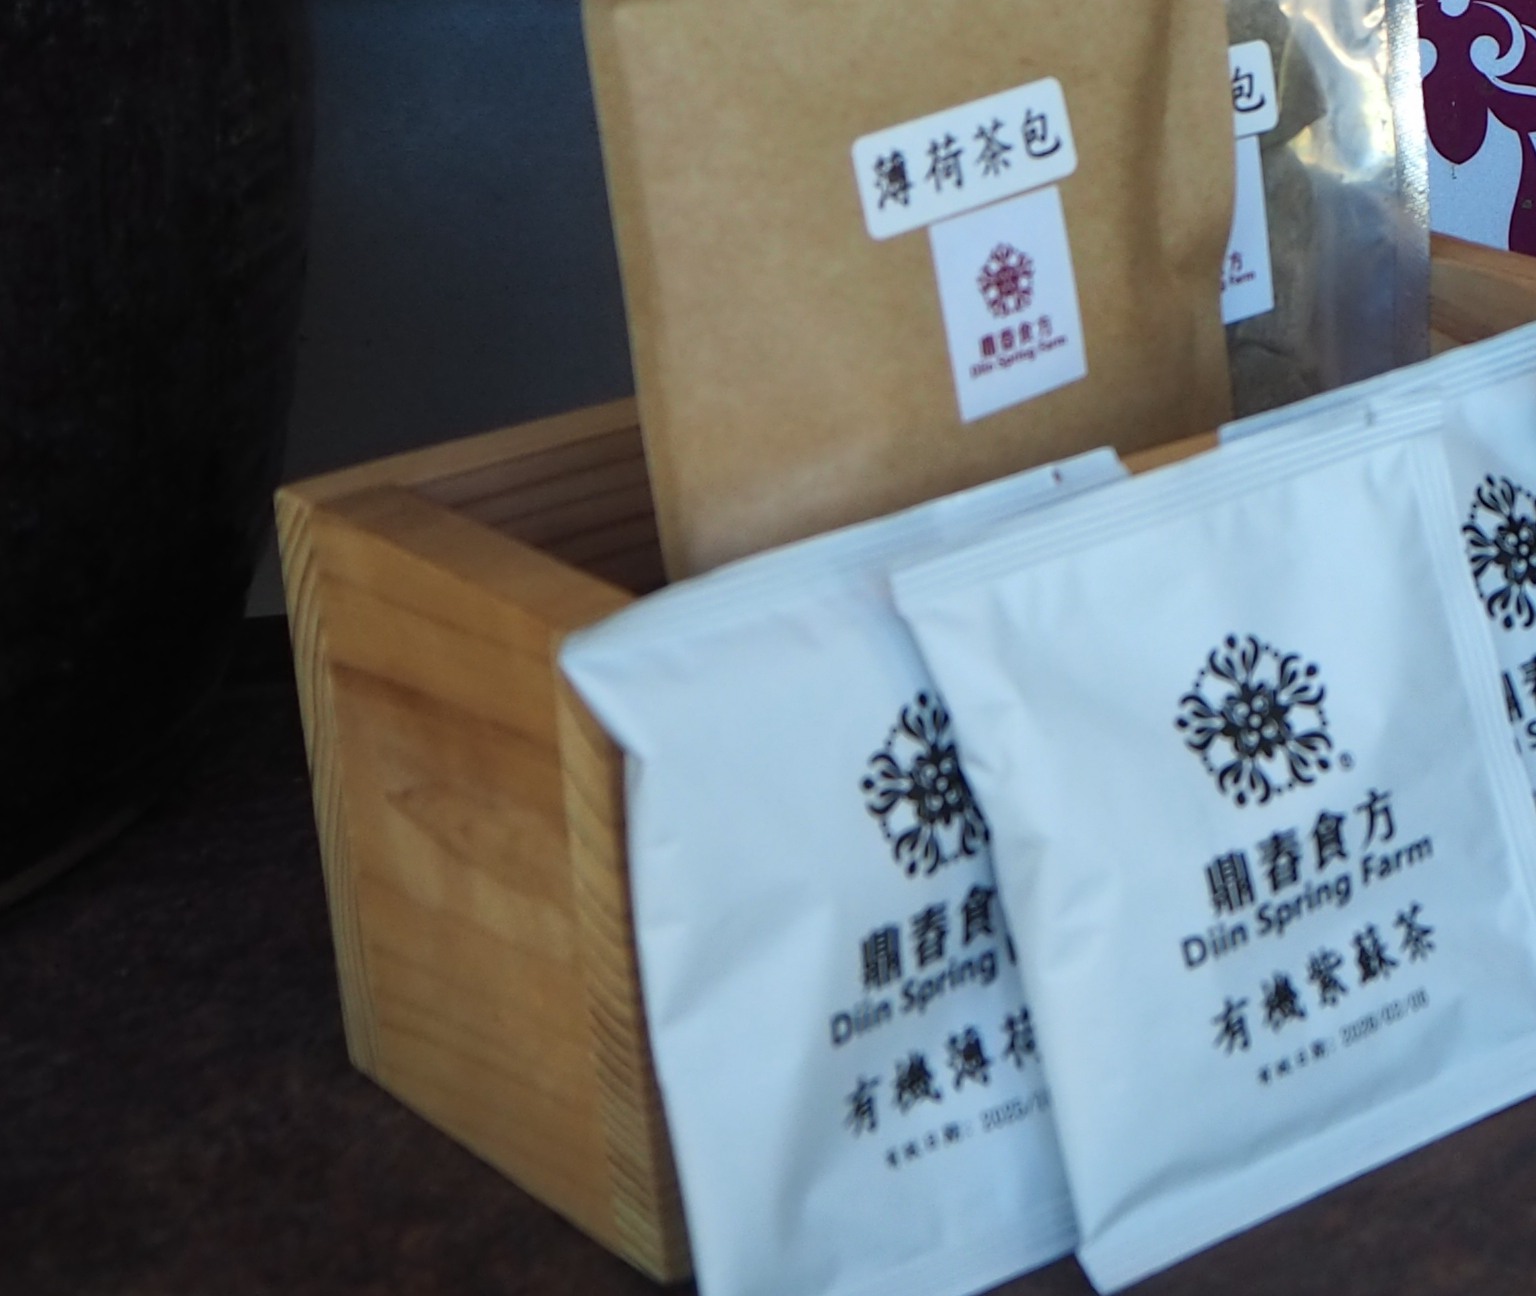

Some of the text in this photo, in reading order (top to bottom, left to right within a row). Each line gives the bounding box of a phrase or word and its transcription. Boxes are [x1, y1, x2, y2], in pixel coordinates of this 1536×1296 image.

[874, 108, 1062, 209] 薄荷茶包
[1180, 834, 1434, 971] Diin Spring Farm
[1204, 786, 1396, 916] 鼎春食方
[831, 999, 893, 1049] Diin
[901, 949, 998, 1016] Spring
[1211, 901, 1435, 1055] 有機紫蘇茶
